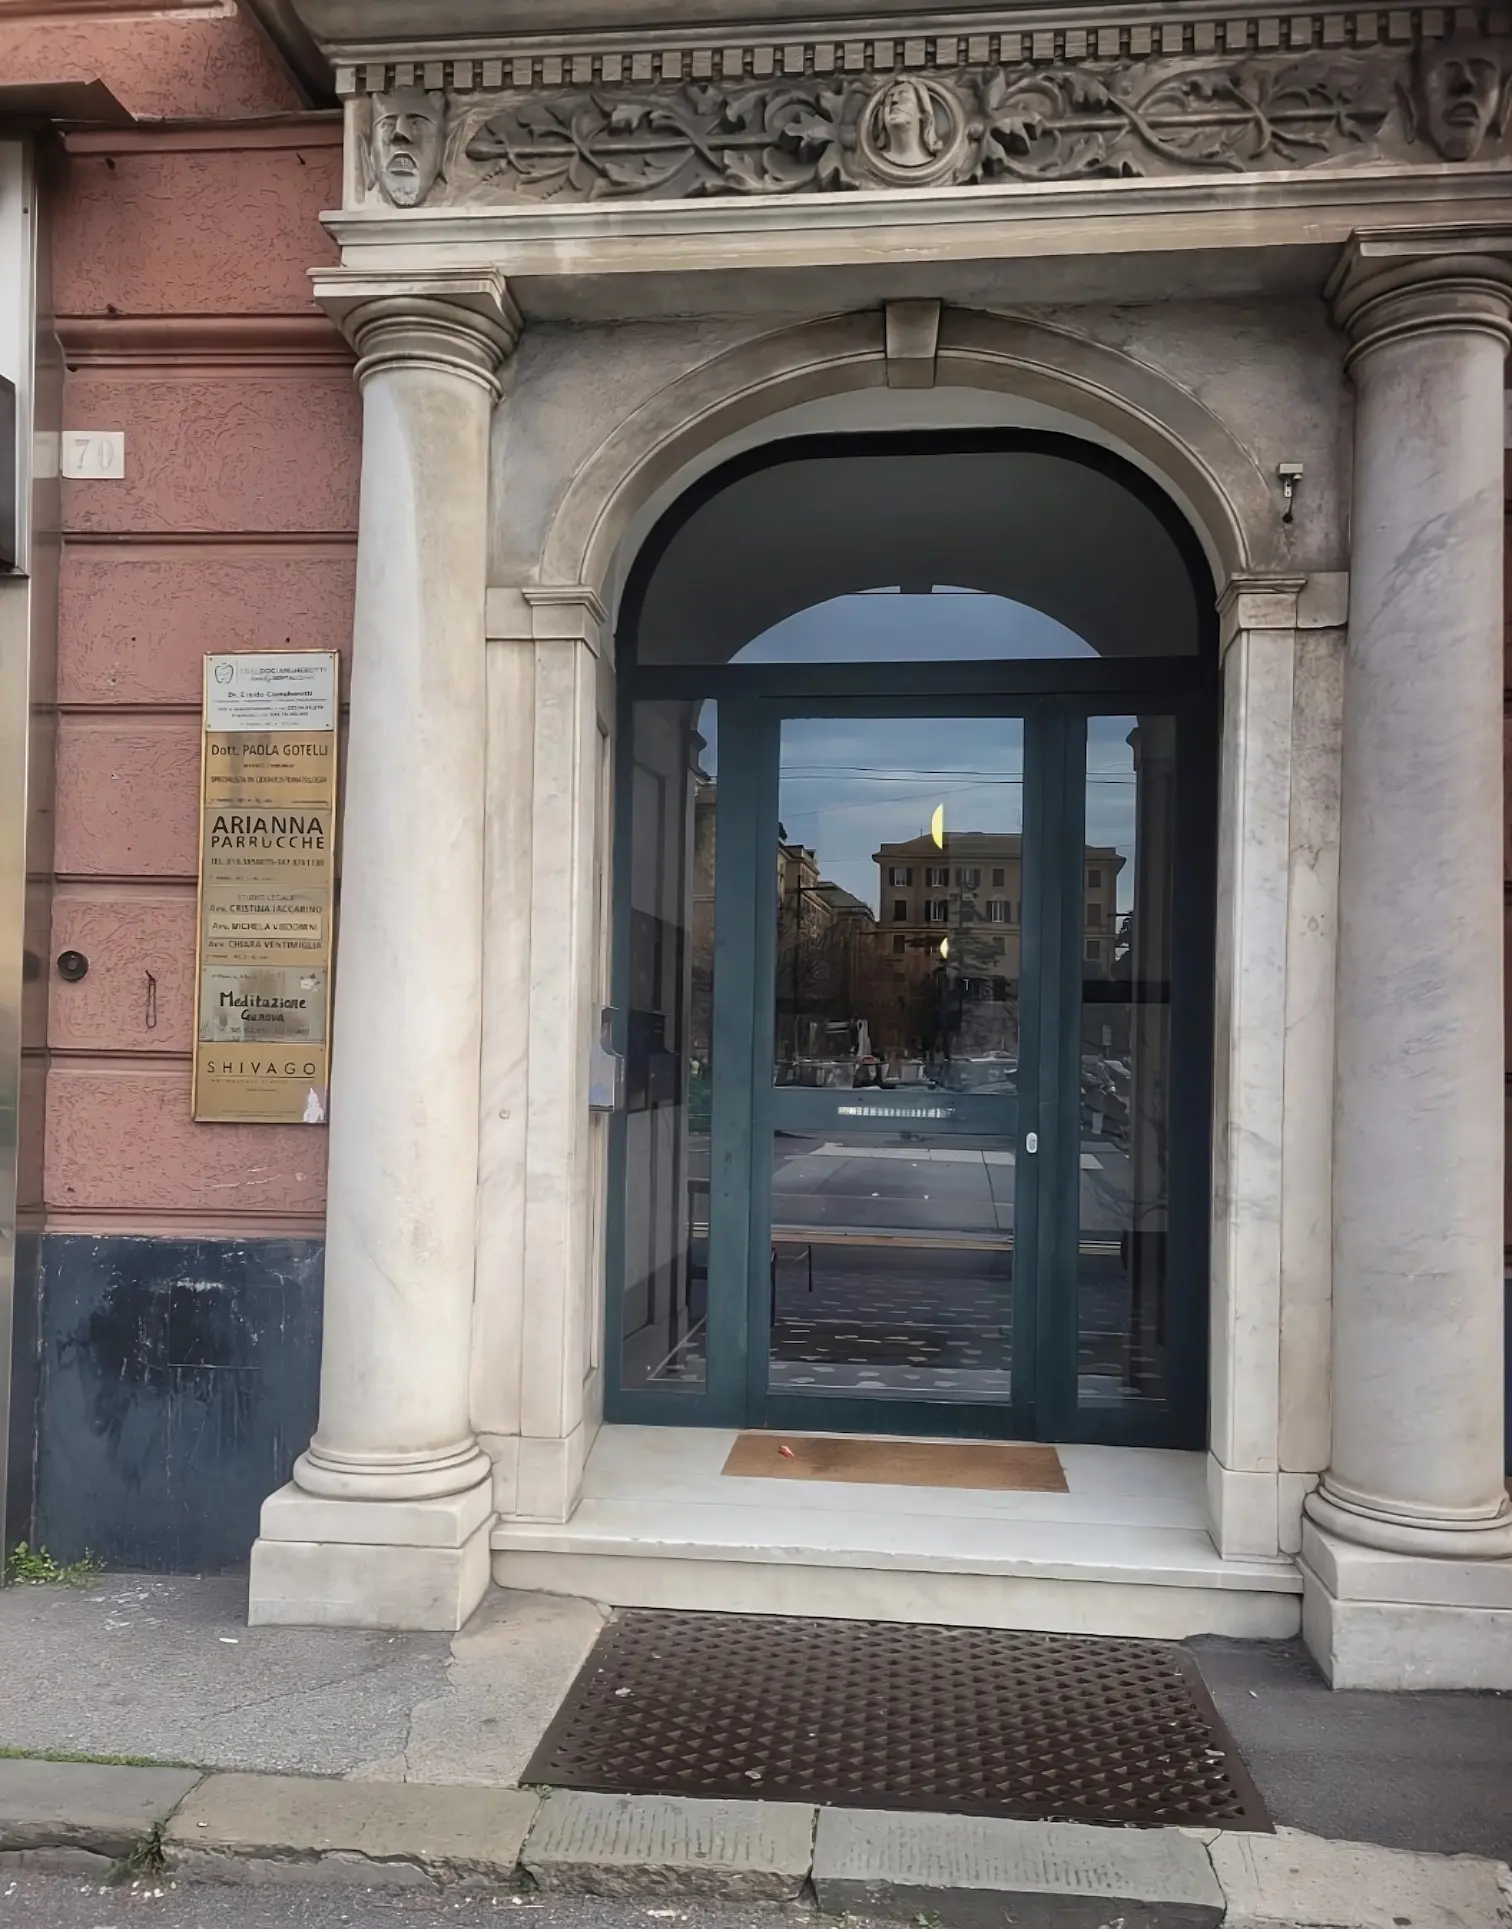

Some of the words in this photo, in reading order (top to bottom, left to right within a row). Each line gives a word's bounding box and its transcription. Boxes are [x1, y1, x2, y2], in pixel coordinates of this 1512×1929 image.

[243, 744, 279, 756] PAOLA
[283, 744, 328, 756] GOTELLI
[212, 815, 324, 835] ARIANNA
[211, 836, 324, 849] PARRUCCHE
[229, 904, 270, 913] CRISTINA
[228, 940, 261, 948] CHIARA
[220, 990, 307, 1009] Meditazione
[240, 1009, 284, 1022] Genova
[207, 1061, 316, 1075] SHIVAGO
